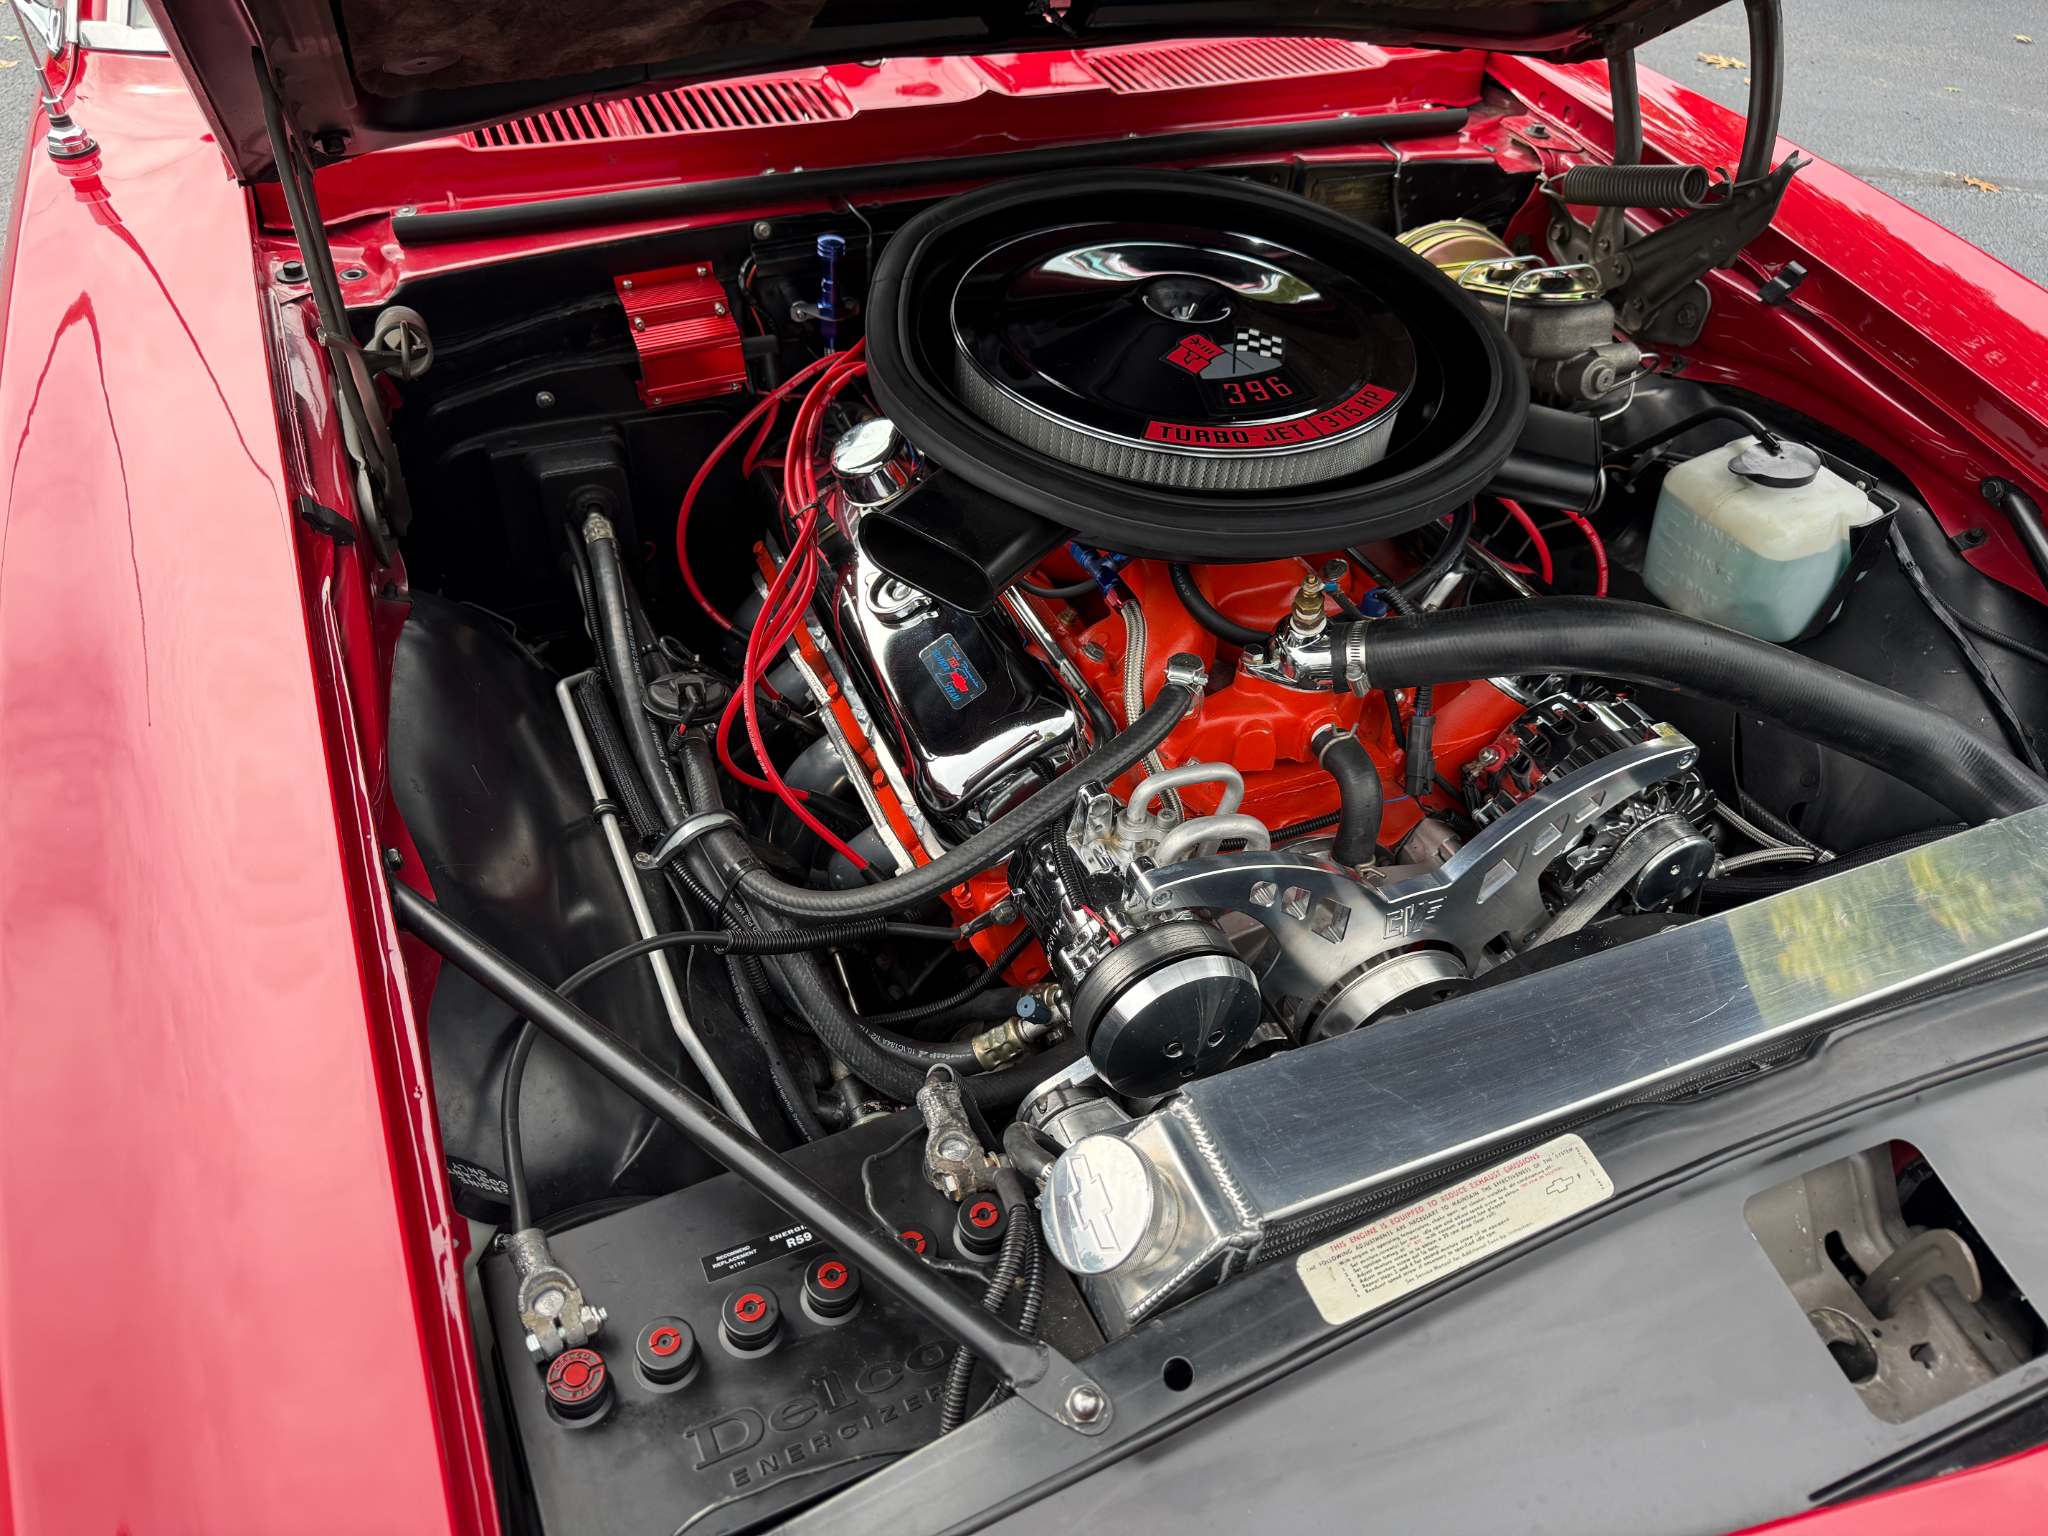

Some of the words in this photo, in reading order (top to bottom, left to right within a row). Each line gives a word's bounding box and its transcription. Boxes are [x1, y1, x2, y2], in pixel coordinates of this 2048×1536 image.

[1223, 376, 1293, 404] 396
[1160, 423, 1306, 444] TURBO-JET
[1320, 404, 1363, 428] 375
[1357, 390, 1386, 410] HP
[1700, 521, 1740, 554] PINTS
[1683, 544, 1692, 558] 2
[1173, 562, 1190, 597] 249A2
[1685, 580, 1718, 608] PINT
[932, 650, 951, 671] NUMBER
[947, 656, 960, 669] THE
[945, 685, 961, 702] TEAM
[757, 754, 769, 775] WIRES
[735, 902, 745, 915] WP
[770, 1074, 783, 1089] Fuel
[777, 1088, 795, 1113] Injection
[791, 1112, 809, 1136] Systems
[447, 1167, 509, 1188] COOLANT
[452, 1162, 487, 1177] ONLY
[458, 1176, 509, 1195] ENGINE
[1318, 1247, 1353, 1267] FOLLOWING
[1353, 1229, 1393, 1250] ADJUSTMENTS
[1394, 1223, 1406, 1232] ARE
[1407, 1208, 1439, 1226] NECESSARY
[1440, 1203, 1450, 1211] TO
[1450, 1190, 1480, 1206] MAINTAIN
[1480, 1184, 1492, 1193] THE
[1492, 1166, 1531, 1187] EFFECTIVENESS
[1542, 1156, 1553, 1164] THE
[1554, 1147, 1574, 1159] SYSTEM
[1329, 1240, 1347, 1252] THIS
[1348, 1226, 1378, 1243] ENGINE
[1379, 1221, 1388, 1229] IS
[1389, 1205, 1425, 1225] EQUIPPED
[1426, 1198, 1438, 1208] TO
[1439, 1185, 1468, 1202] REDUCE
[1468, 1170, 1502, 1188] EXHAUST
[1502, 1152, 1540, 1173] EMISSIONS
[785, 1232, 812, 1248] R59
[712, 1249, 757, 1269] REPLACEMENT
[715, 1245, 751, 1261] RECOMMEND
[728, 1260, 746, 1270] WITH
[554, 1351, 590, 1370] DELCO
[684, 1343, 956, 1471] Delco
[731, 1383, 950, 1487] ENERGIZER
